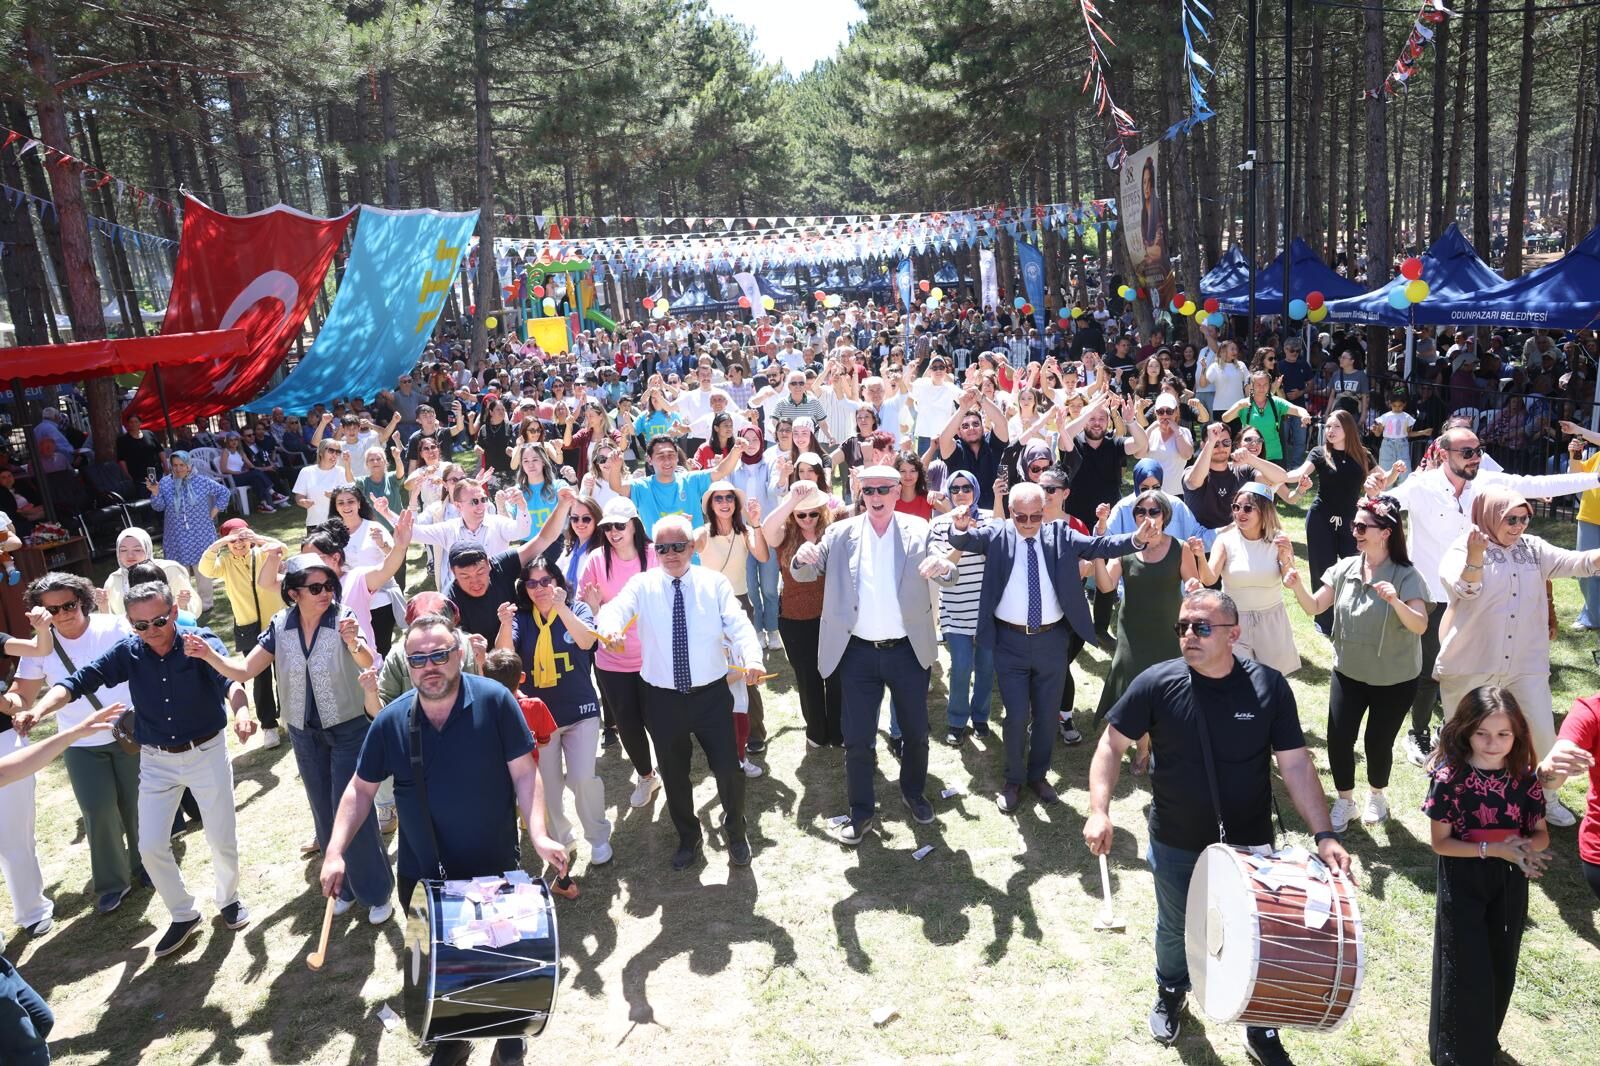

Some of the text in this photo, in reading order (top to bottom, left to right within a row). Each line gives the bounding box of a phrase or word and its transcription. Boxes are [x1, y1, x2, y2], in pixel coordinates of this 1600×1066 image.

[1450, 310, 1548, 322] ODUNPAZARI BELEDİYESİ
[1335, 380, 1358, 391] LFT
[578, 702, 597, 715] 1972
[1465, 772, 1508, 799] CRAZY
